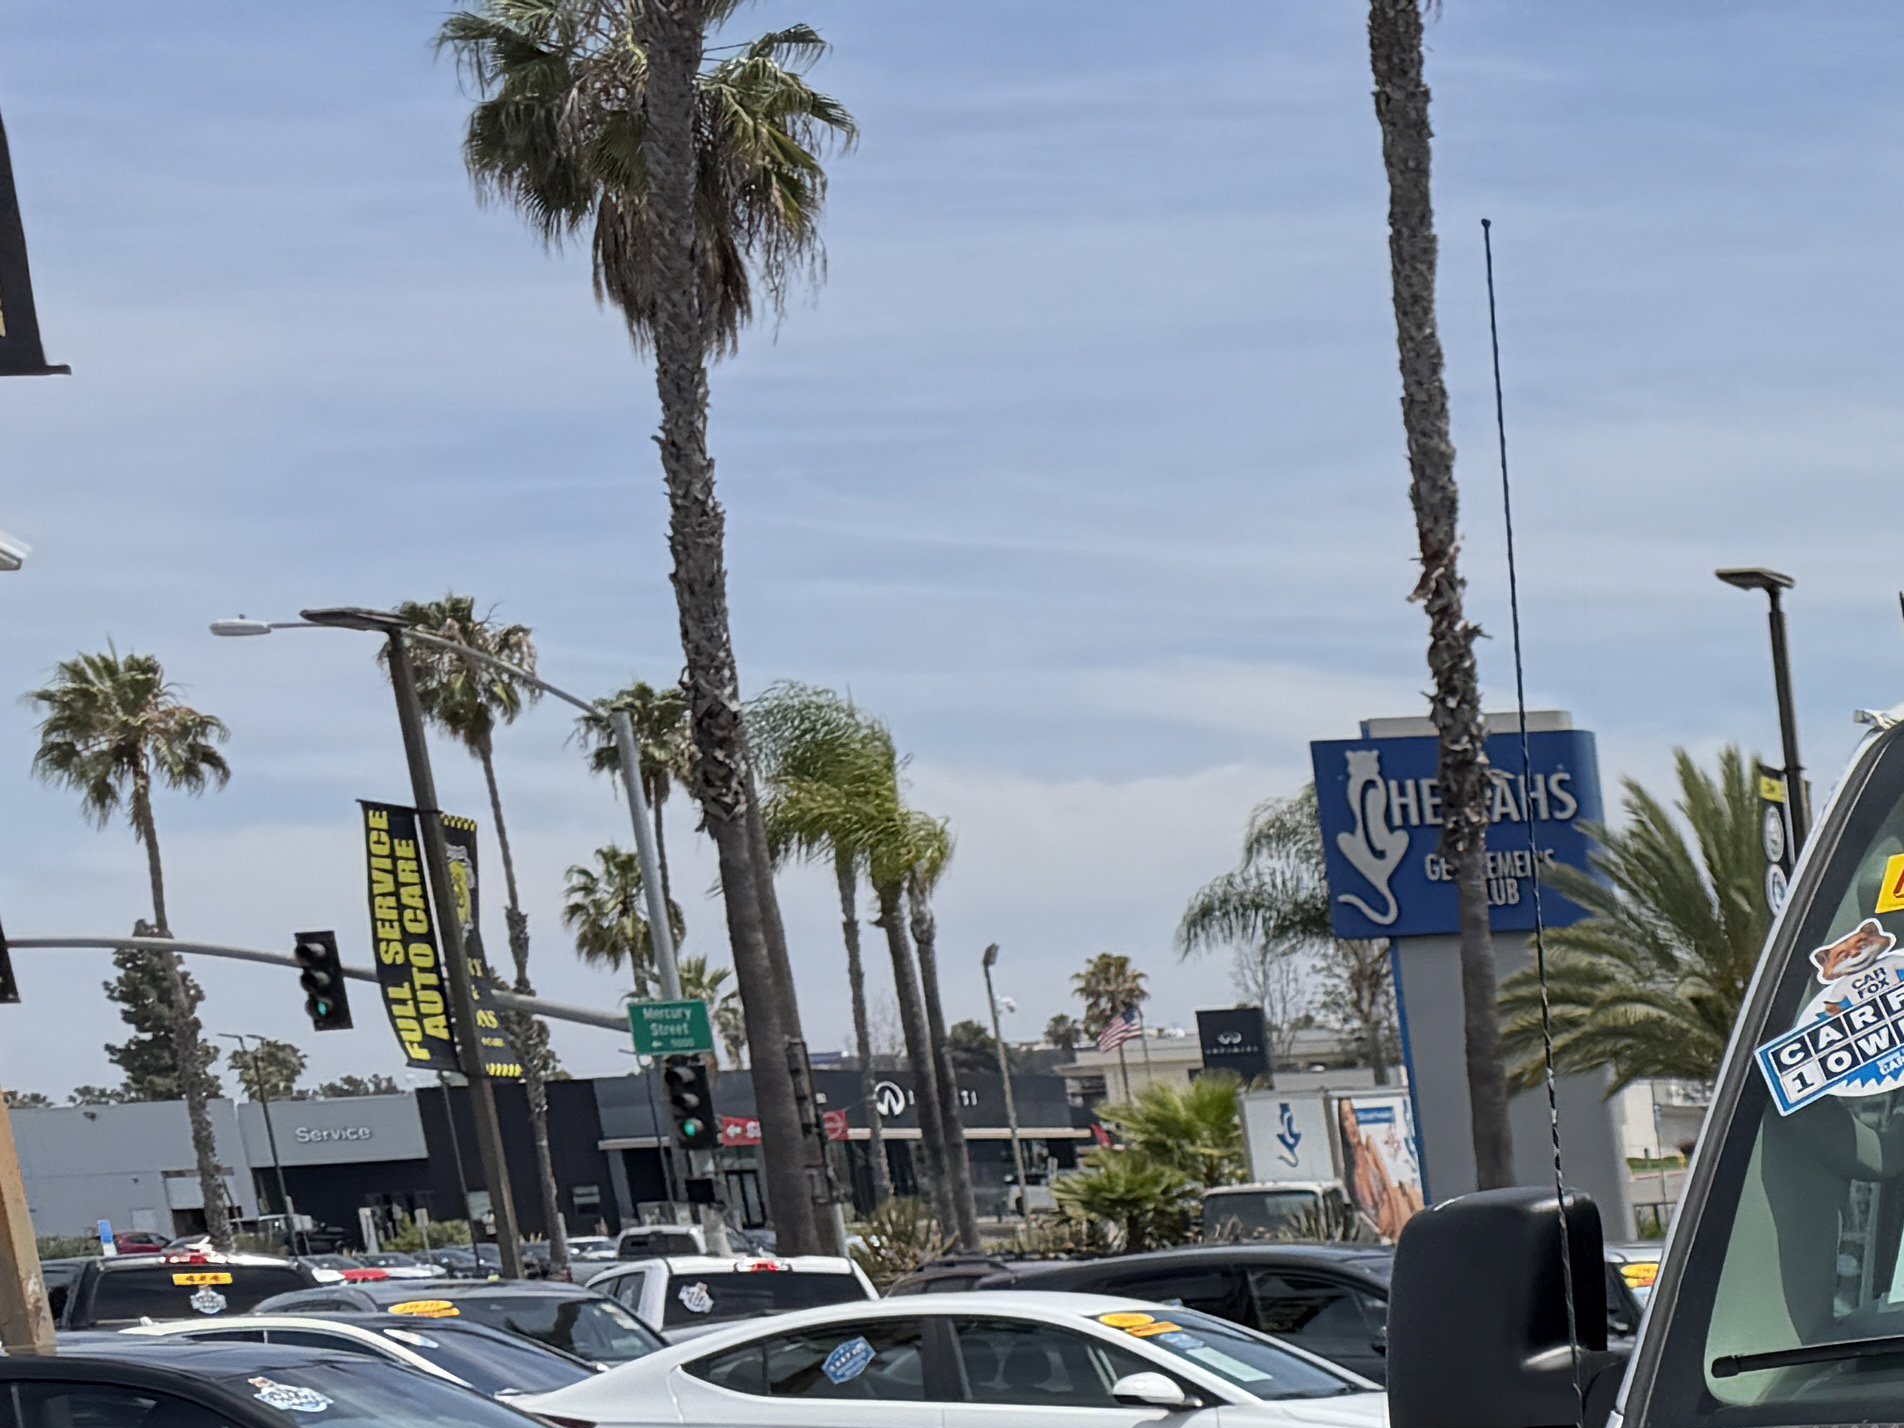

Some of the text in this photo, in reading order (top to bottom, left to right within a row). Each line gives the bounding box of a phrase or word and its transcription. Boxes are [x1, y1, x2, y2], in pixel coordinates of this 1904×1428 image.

[368, 809, 431, 1061] FULL SERVICE
[393, 838, 451, 1041] AUTO CARE
[1851, 966, 1888, 989] CAR
[1857, 977, 1891, 1000] FOX
[643, 1007, 693, 1021] Mercury
[650, 1022, 690, 1037] Street
[1793, 1070, 1816, 1094] 1
[295, 1127, 371, 1142] Service
